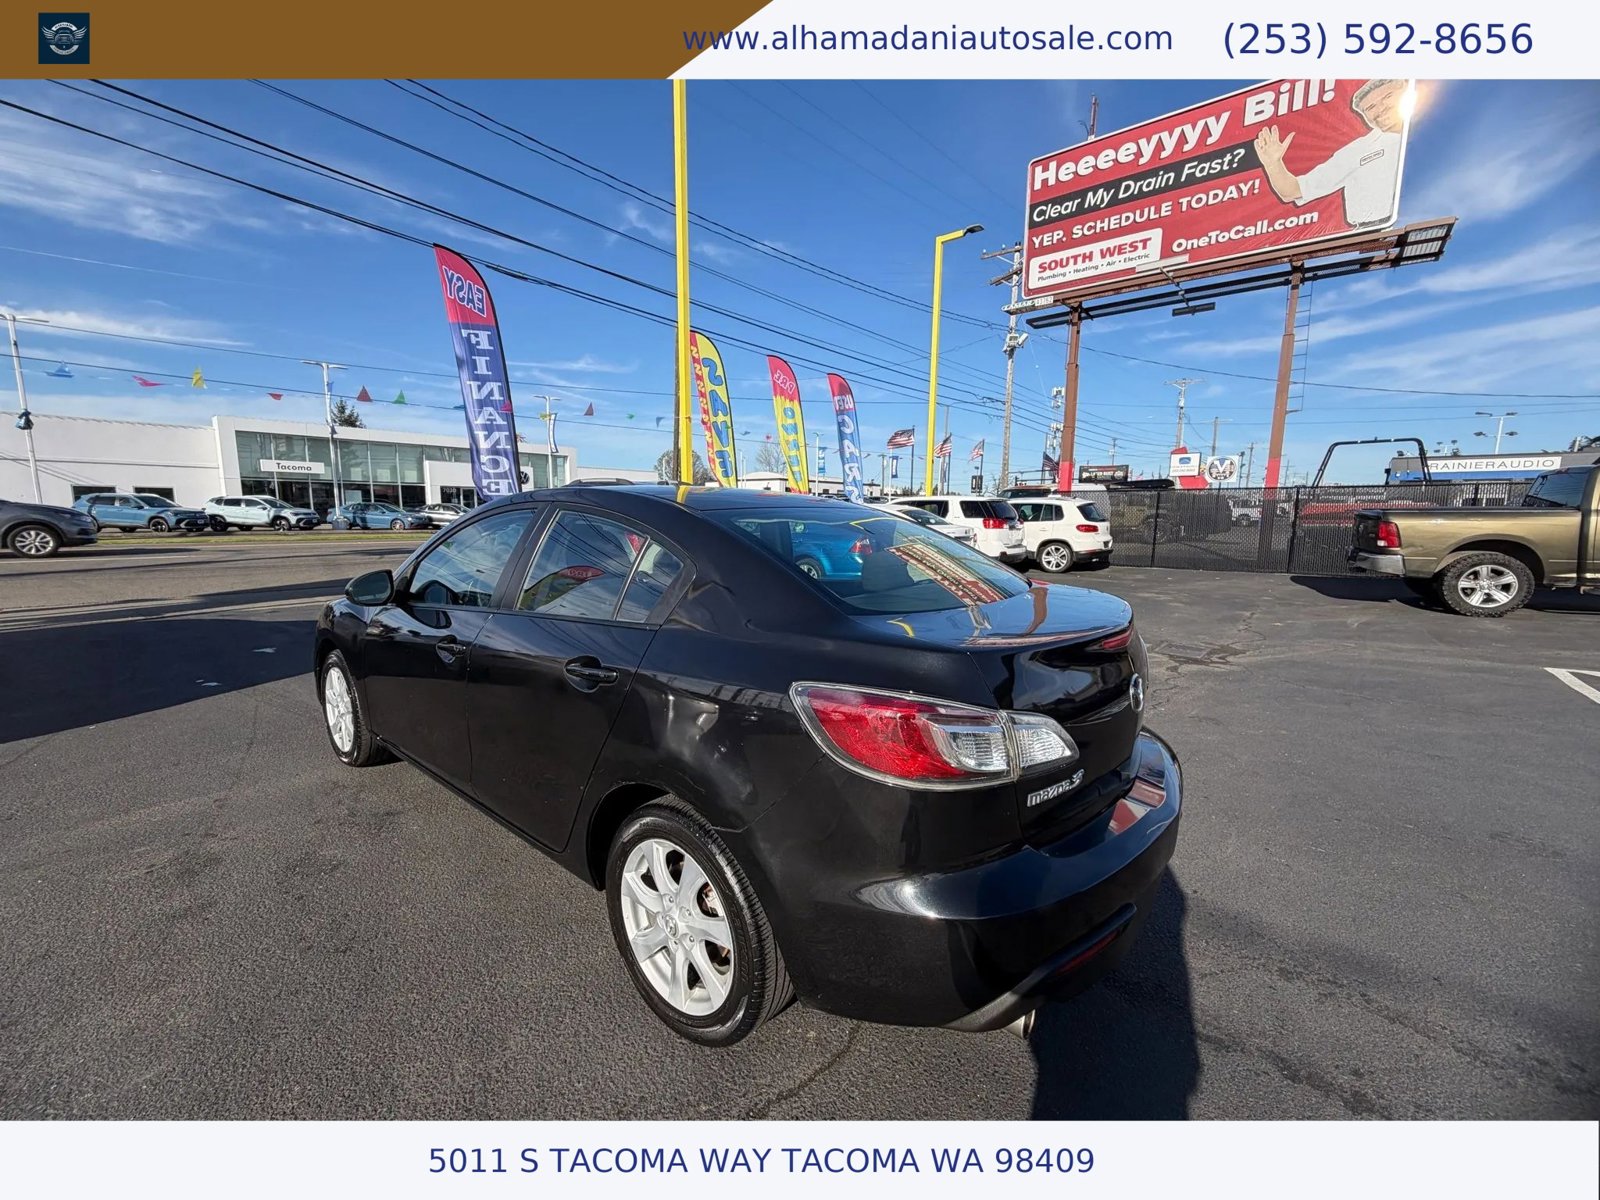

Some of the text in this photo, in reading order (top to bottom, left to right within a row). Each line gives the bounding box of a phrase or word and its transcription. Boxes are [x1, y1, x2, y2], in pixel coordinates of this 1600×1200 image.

[1033, 79, 1336, 191] Heeeeyyyy Bill!
[1033, 148, 1246, 223] Clear My Drain Fast?
[1031, 178, 1261, 250] YEP. SCHEDULE TODAY!
[1172, 211, 1319, 253] OneToCall.com
[1037, 237, 1149, 274] SOUTH WEST
[1037, 252, 1150, 283] Plumbing Heating Air Electric
[275, 462, 312, 472] Tacoma
